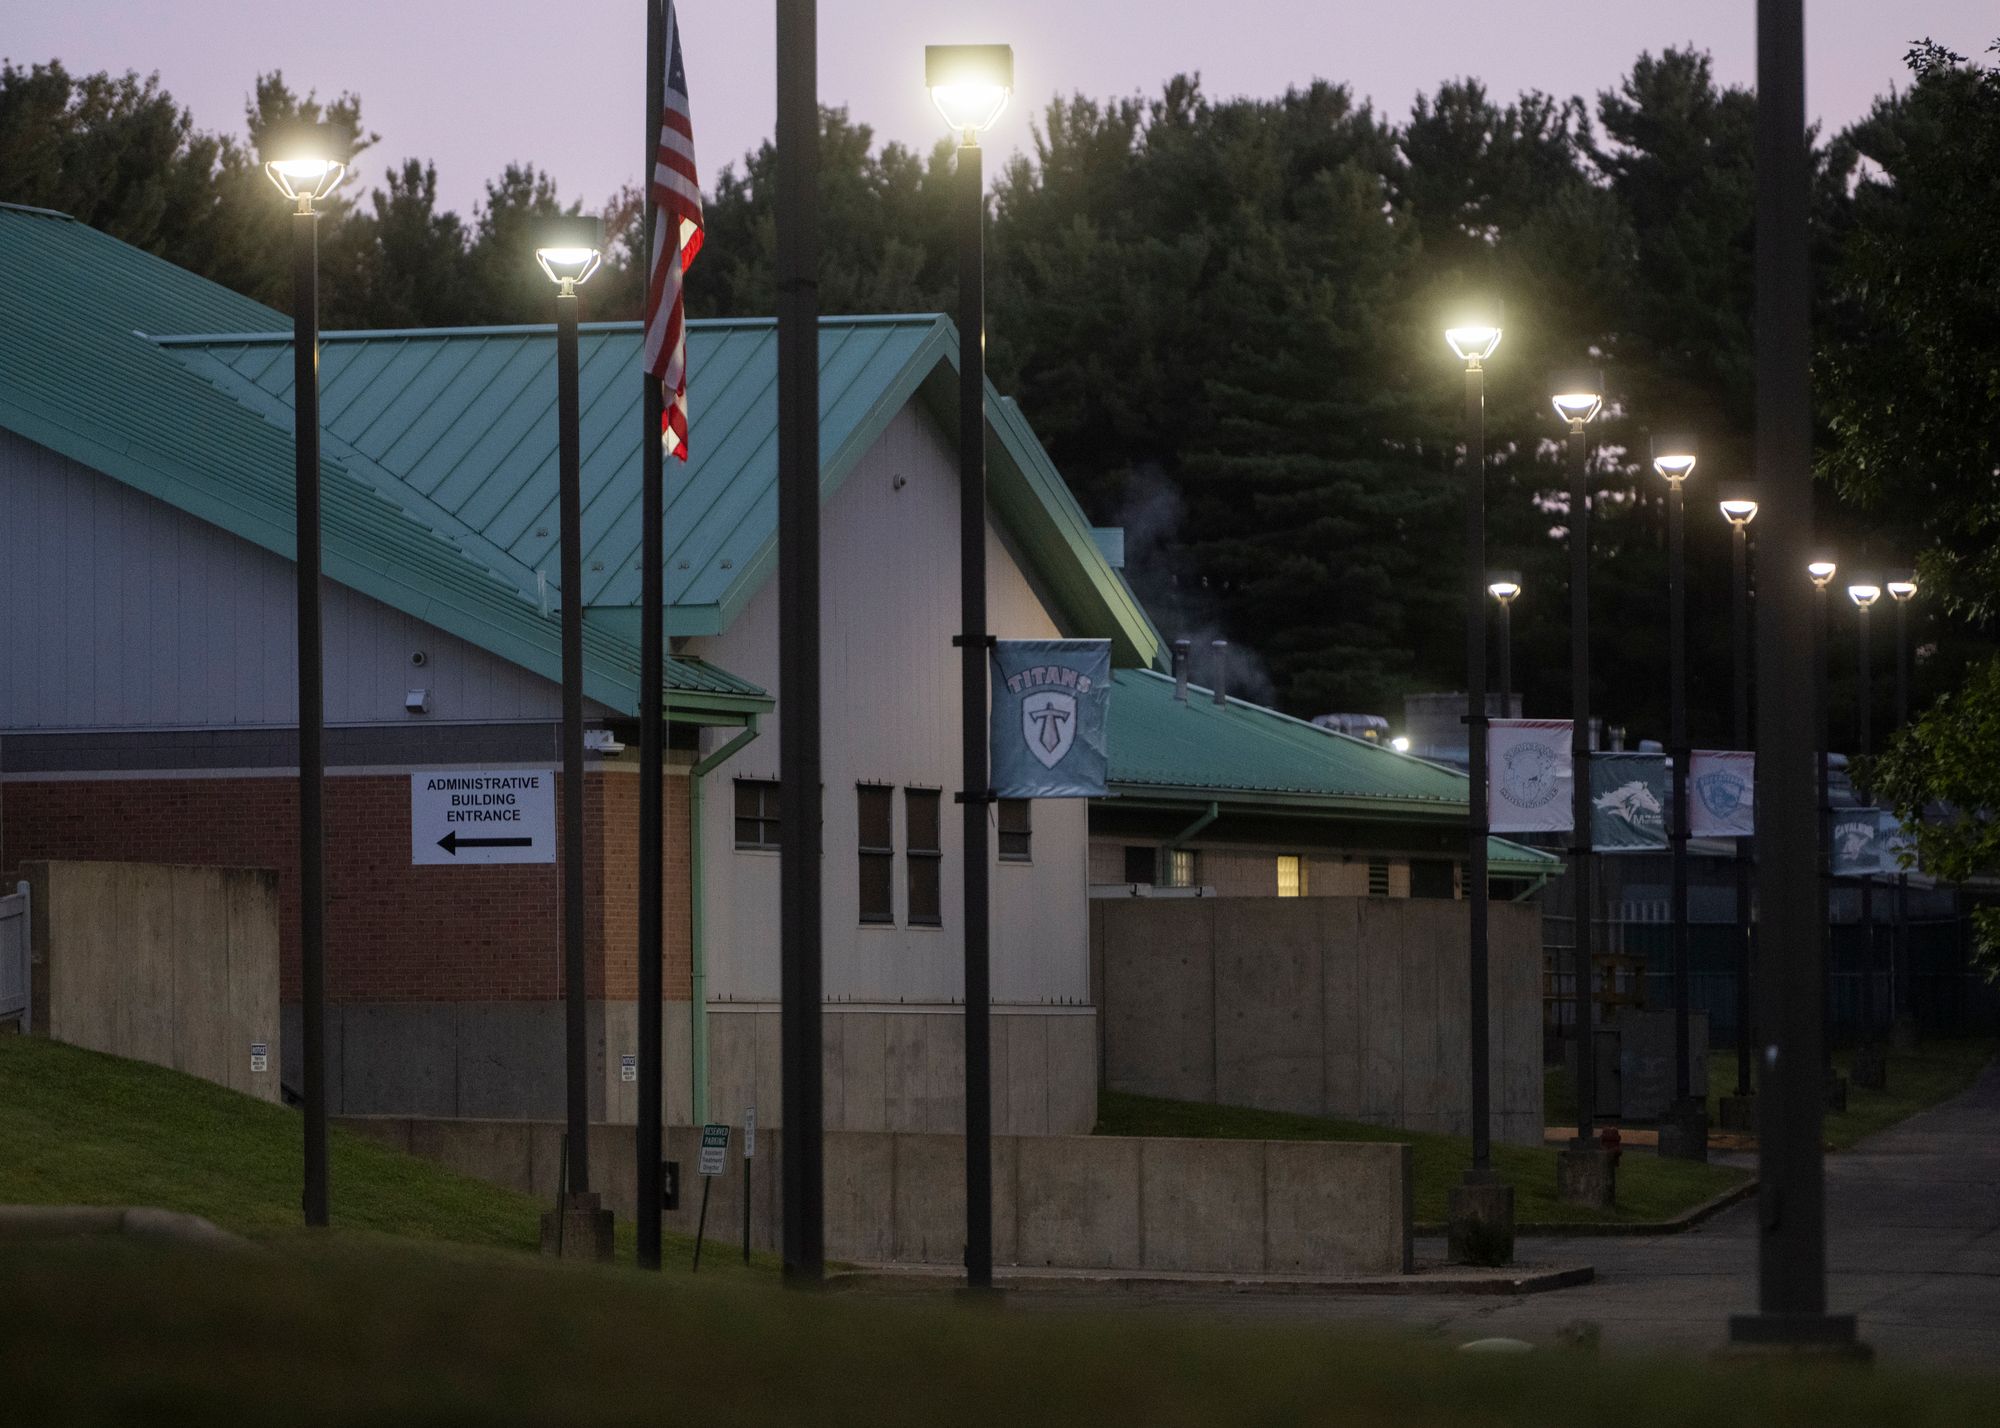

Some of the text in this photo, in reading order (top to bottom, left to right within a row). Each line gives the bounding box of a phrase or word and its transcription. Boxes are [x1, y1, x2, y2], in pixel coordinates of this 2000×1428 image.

[1007, 665, 1092, 694] TITANS
[427, 777, 539, 791] ADMINISTRATIVE
[451, 794, 516, 806] BUILDING
[447, 809, 521, 822] ENTRANCE
[705, 1127, 729, 1136] RESERVED
[704, 1136, 726, 1145] PARKING
